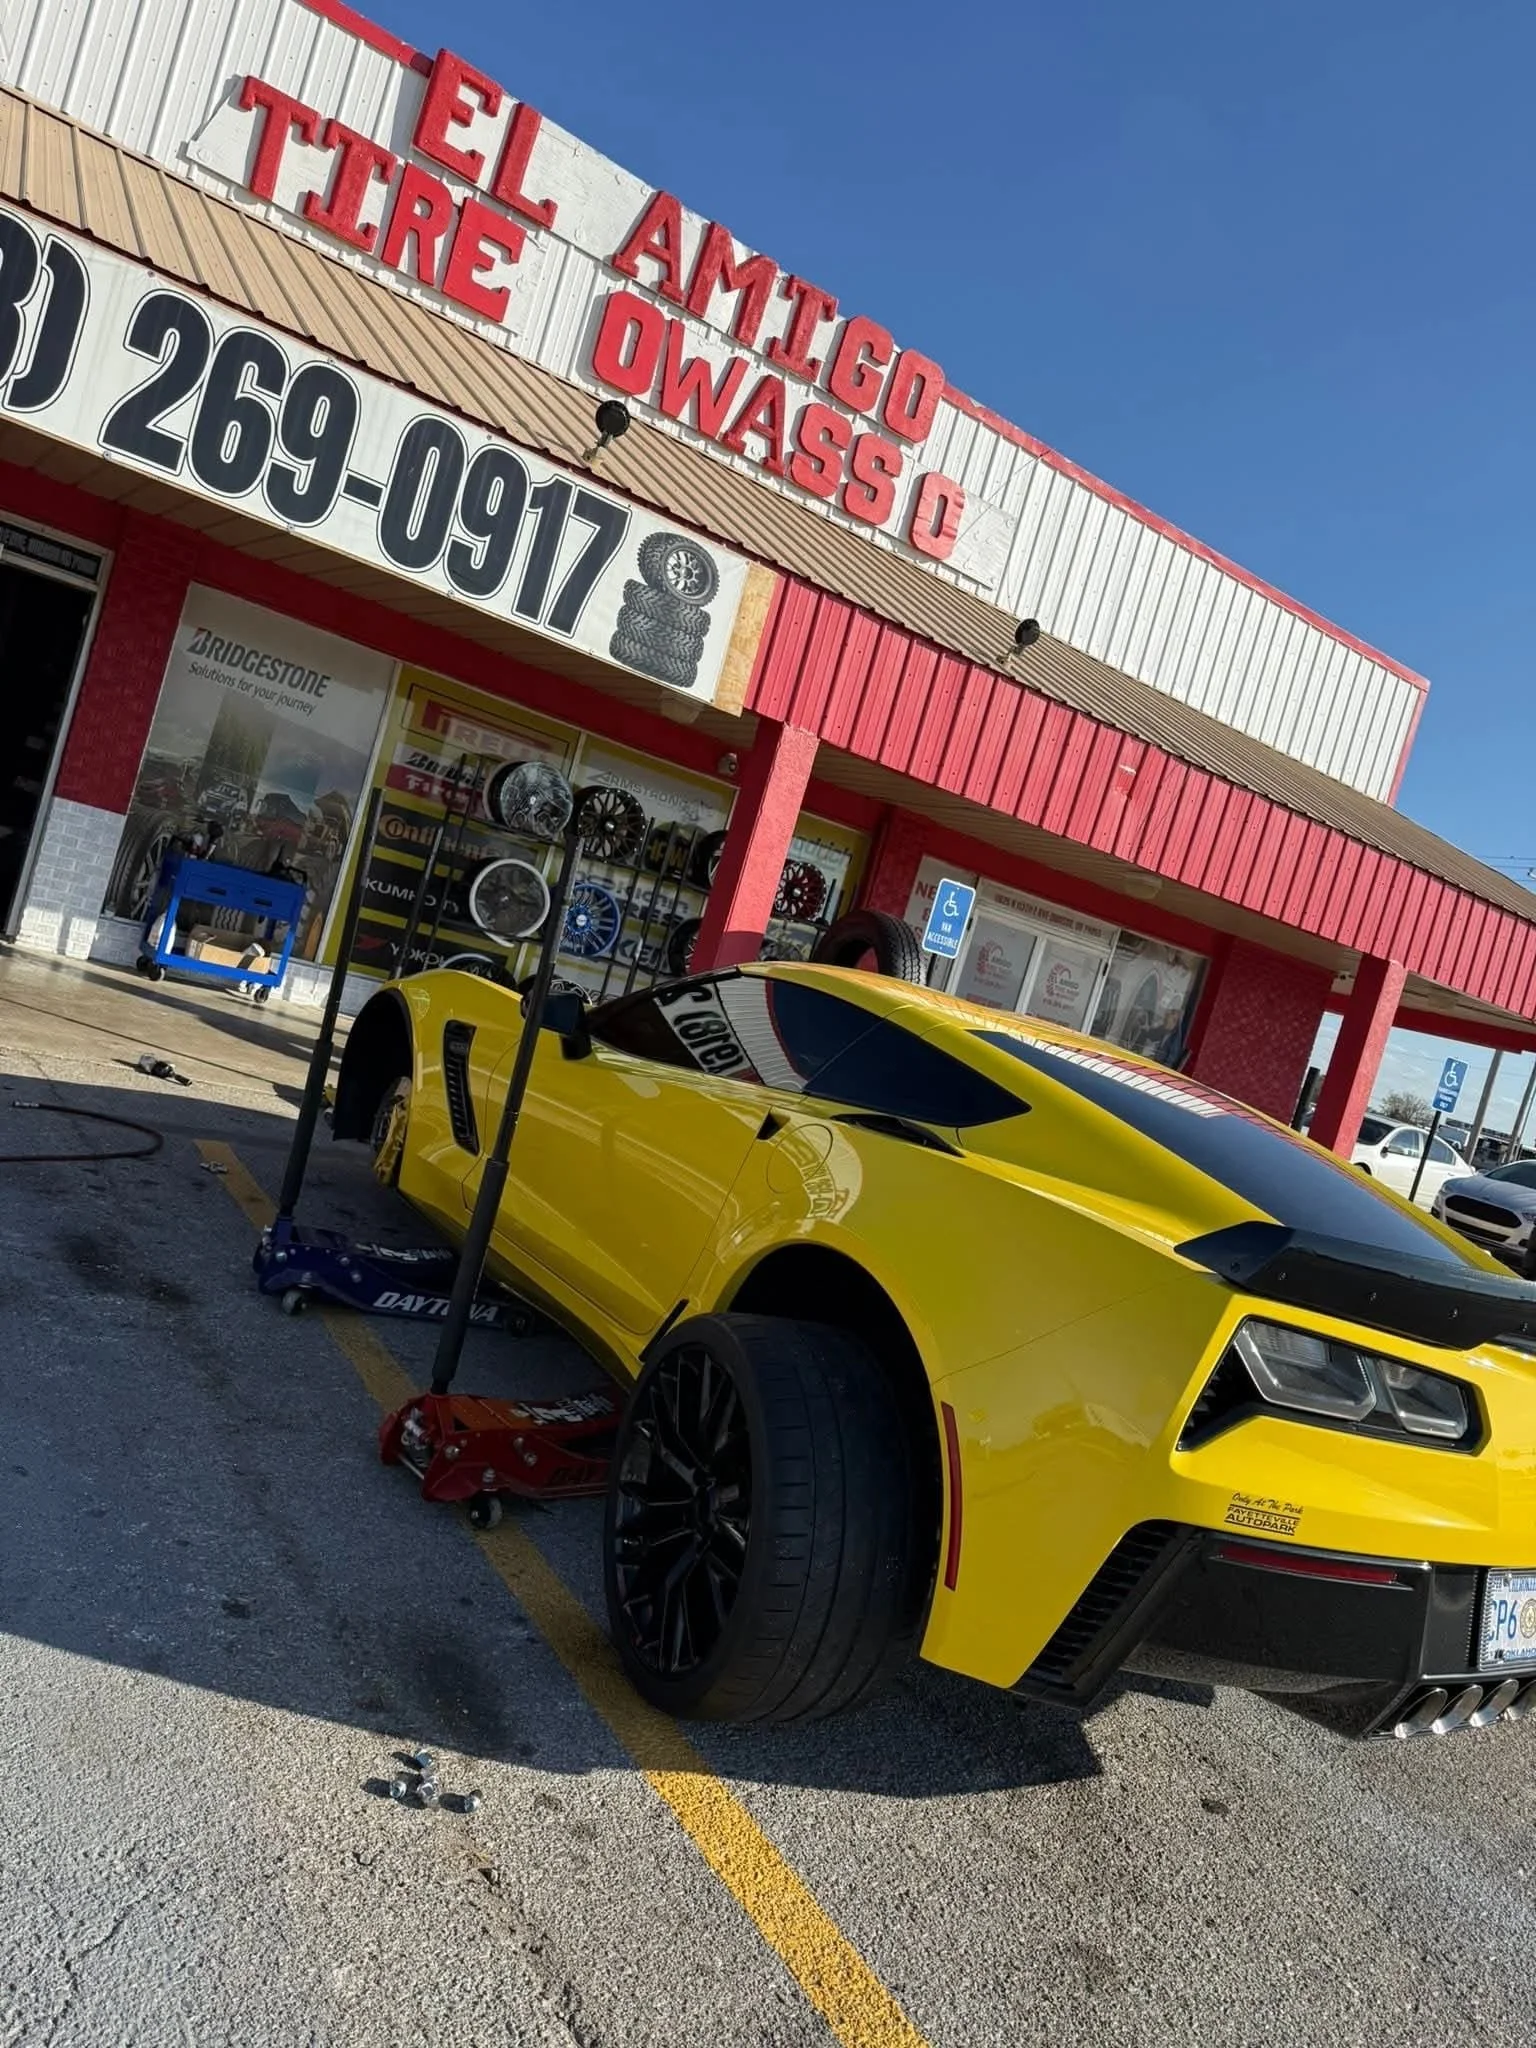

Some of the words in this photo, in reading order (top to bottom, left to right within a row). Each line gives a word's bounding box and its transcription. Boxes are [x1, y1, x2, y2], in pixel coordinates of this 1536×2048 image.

[239, 75, 527, 323] TIRE
[412, 48, 558, 229] EL
[612, 190, 945, 443] AMIGO
[98, 288, 632, 638] 269-0917
[186, 627, 331, 697] BRIDGESTONE
[188, 661, 237, 688] Solutions
[237, 677, 252, 693] for
[253, 684, 278, 700] your
[275, 691, 317, 716] journey
[915, 881, 938, 900] NE
[927, 931, 958, 949] ACCESSIBLE
[372, 1291, 500, 1322] DAYTNA
[1225, 1513, 1297, 1533] AUTOPARK
[1227, 1506, 1300, 1526] FAYETTEVILLE
[1282, 1502, 1304, 1514] Park
